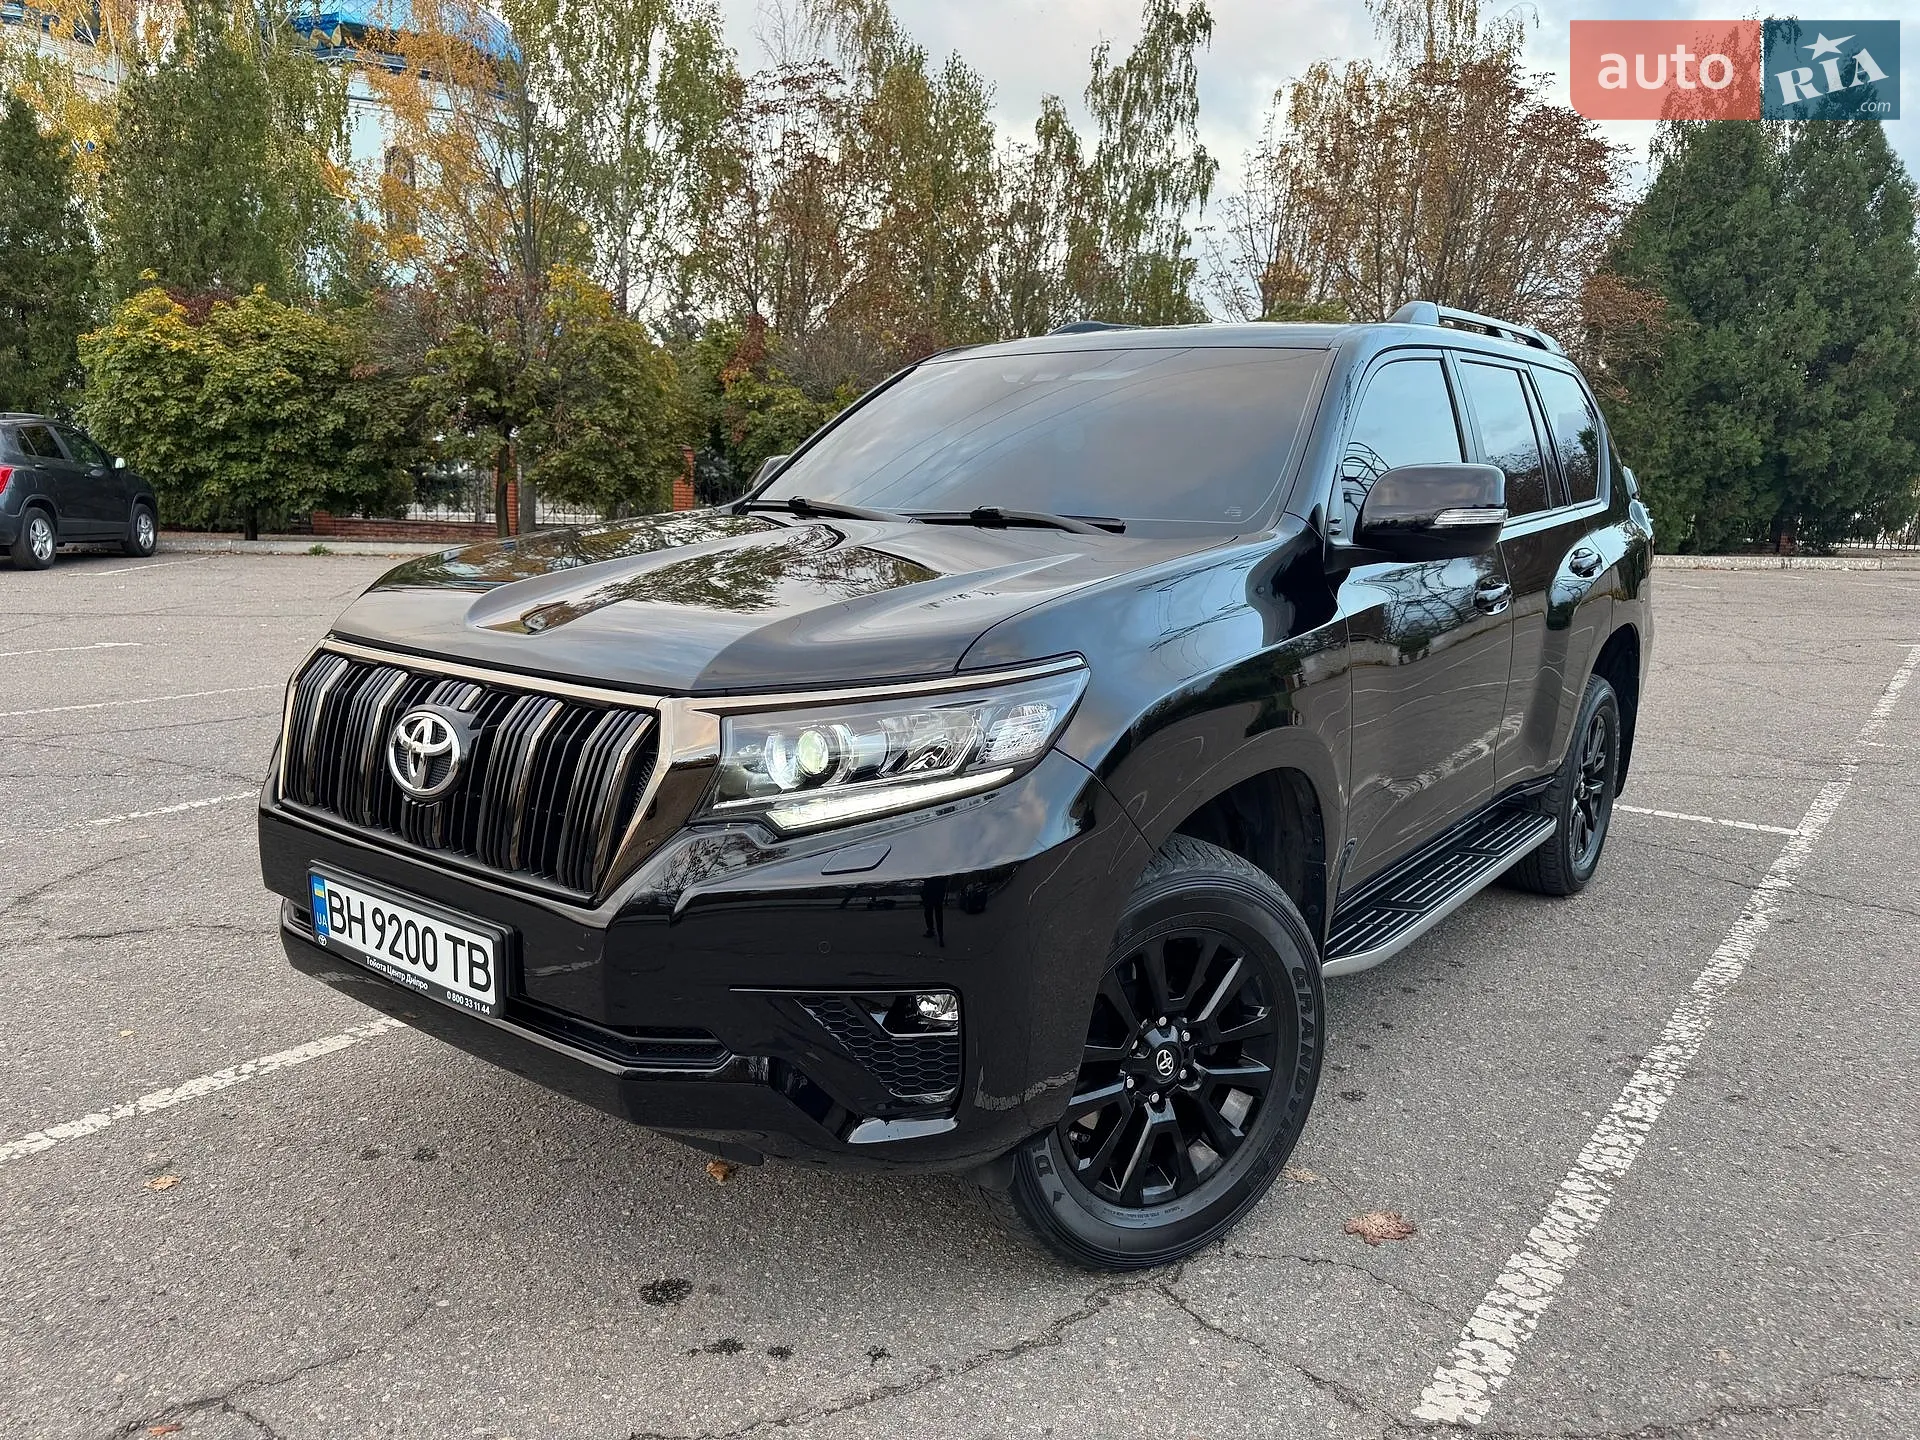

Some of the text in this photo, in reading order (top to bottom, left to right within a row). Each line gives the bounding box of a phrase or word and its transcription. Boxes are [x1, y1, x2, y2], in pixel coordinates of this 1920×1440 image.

[316, 911, 328, 928] UA
[328, 888, 492, 993] BH 9200 TB
[452, 992, 464, 1005] 800
[464, 997, 473, 1009] 33
[473, 1001, 481, 1011] 11
[481, 1004, 491, 1015] 44
